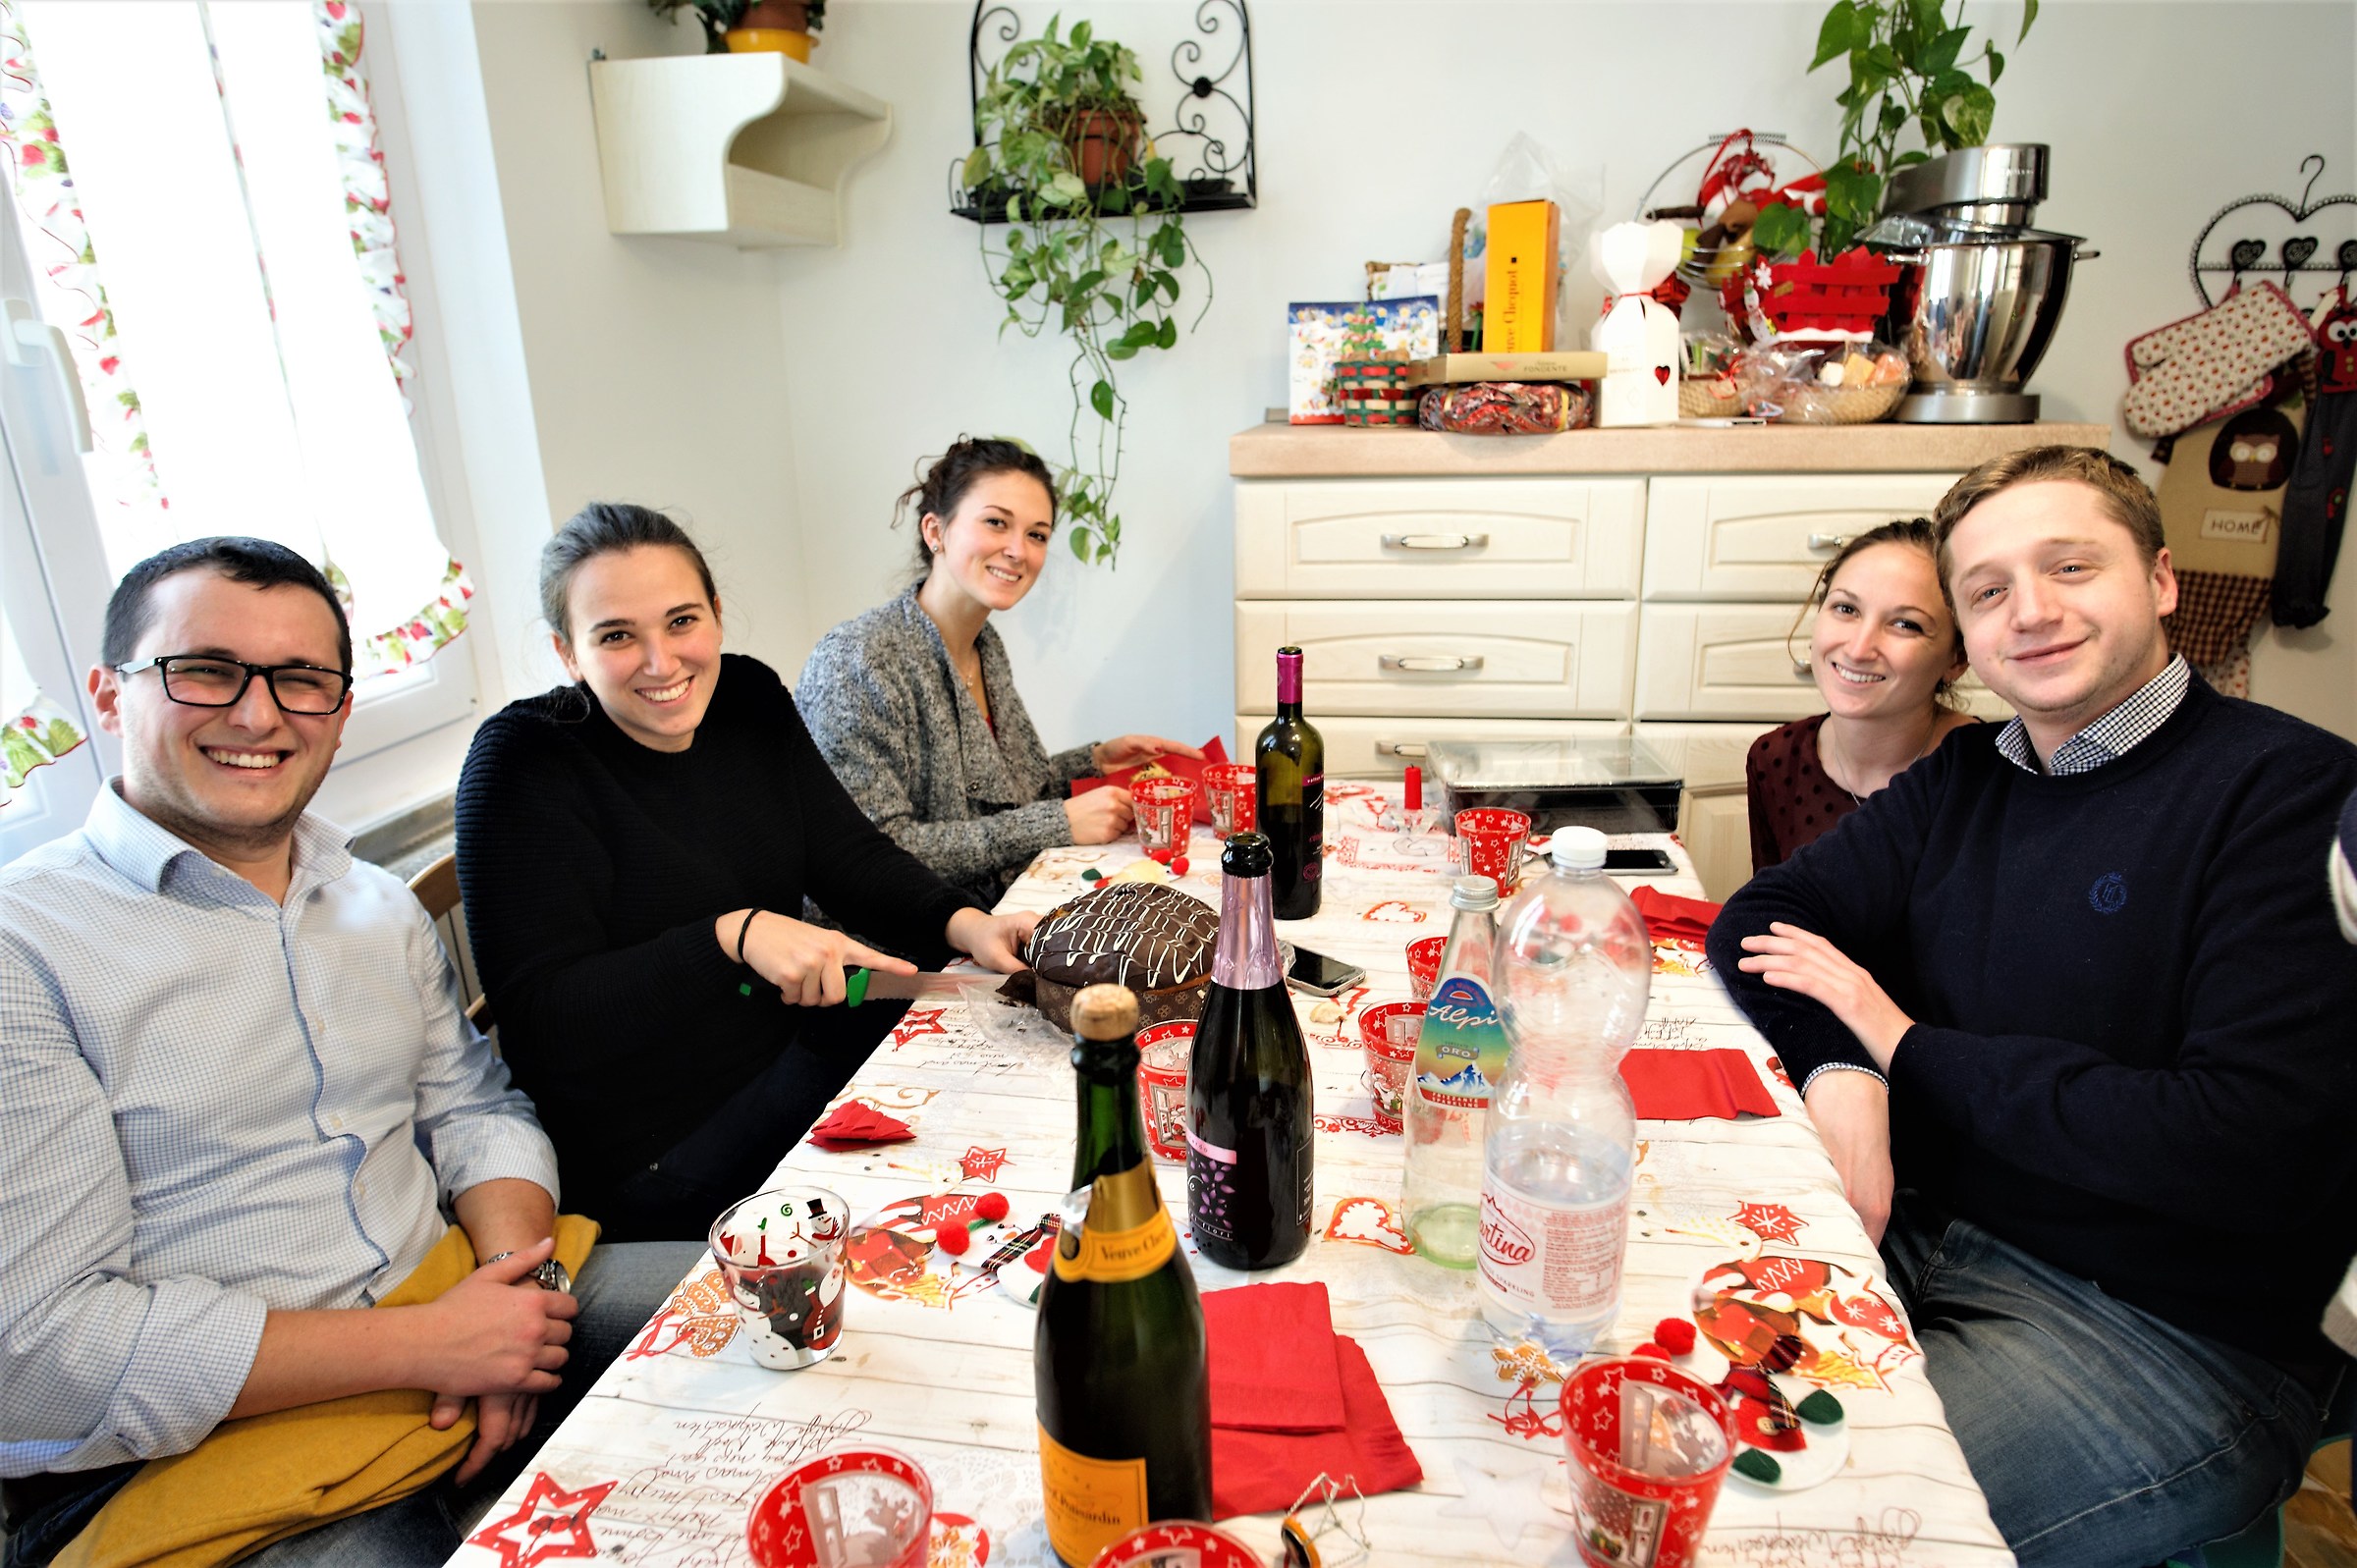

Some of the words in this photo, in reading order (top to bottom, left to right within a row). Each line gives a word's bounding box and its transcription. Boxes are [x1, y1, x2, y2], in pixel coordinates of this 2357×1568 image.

[1504, 270, 1519, 324] Clicquot
[1506, 328, 1516, 353] uve
[1523, 364, 1567, 373] FONDENTE
[2211, 519, 2261, 535] HOME
[1428, 1004, 1499, 1030] Alpi
[1442, 1046, 1470, 1057] ORO
[1432, 1092, 1478, 1103] FRIZZANTE
[1432, 1097, 1478, 1108] SPARKLING
[1479, 1219, 1530, 1263] artina
[1101, 1244, 1140, 1261] Veuve
[1497, 1273, 1535, 1297] SPARKLING
